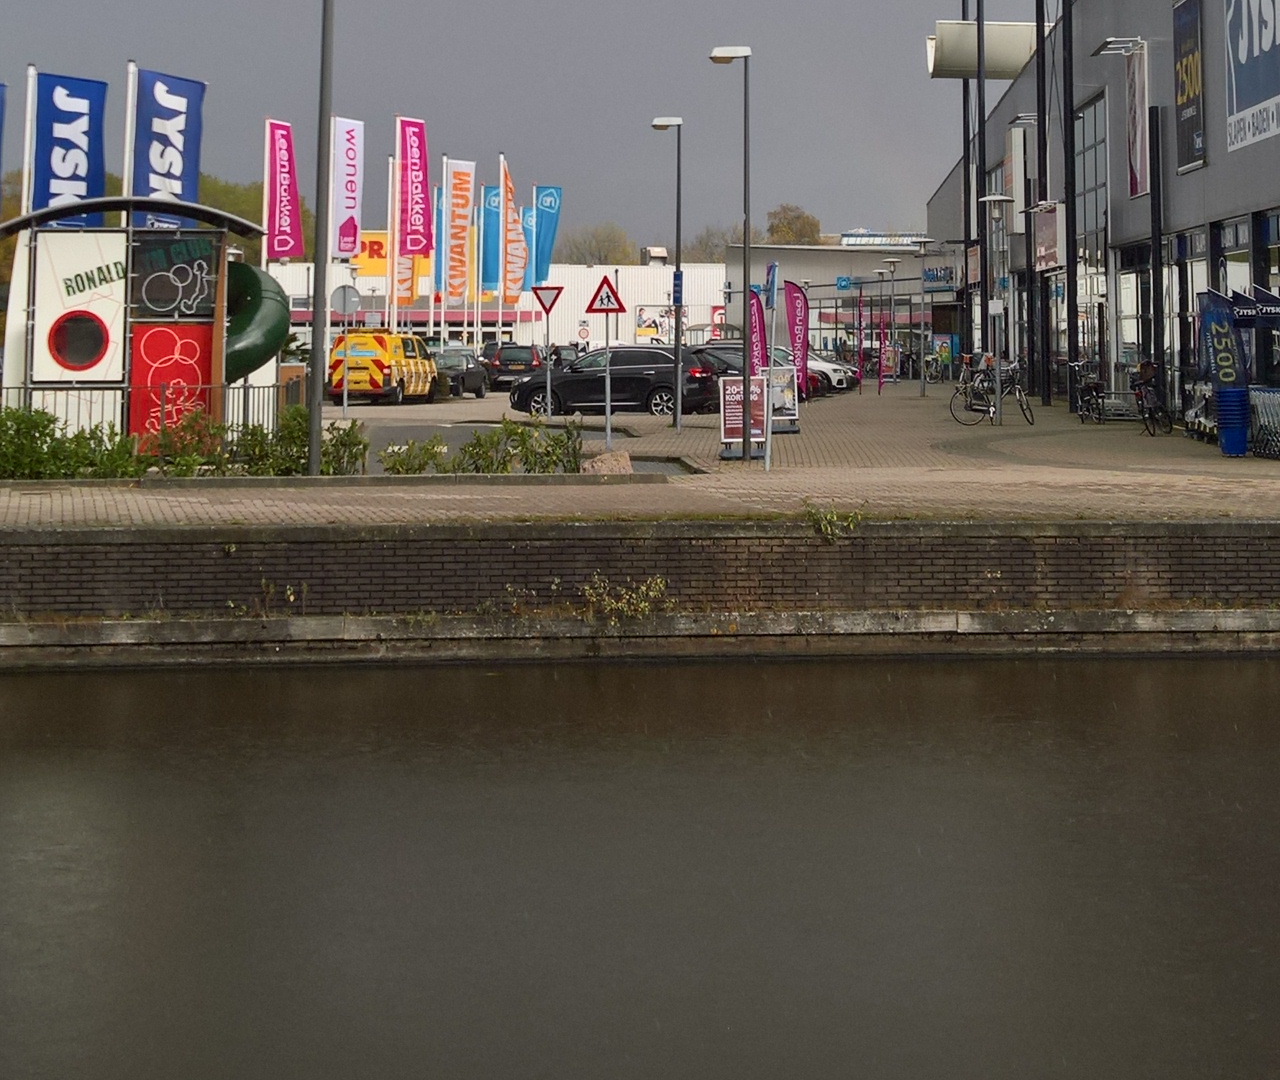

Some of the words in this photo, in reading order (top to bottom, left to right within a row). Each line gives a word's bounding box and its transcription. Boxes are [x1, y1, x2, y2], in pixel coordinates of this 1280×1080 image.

[47, 85, 90, 213] JYSK
[148, 80, 188, 203] JYSK
[1225, 116, 1248, 147] SLAPEN
[1251, 106, 1271, 138] BADEN
[345, 128, 357, 210] wonen
[447, 170, 472, 299] KWANTUM
[61, 260, 127, 298] RONALD
[1211, 321, 1237, 383] 2500
